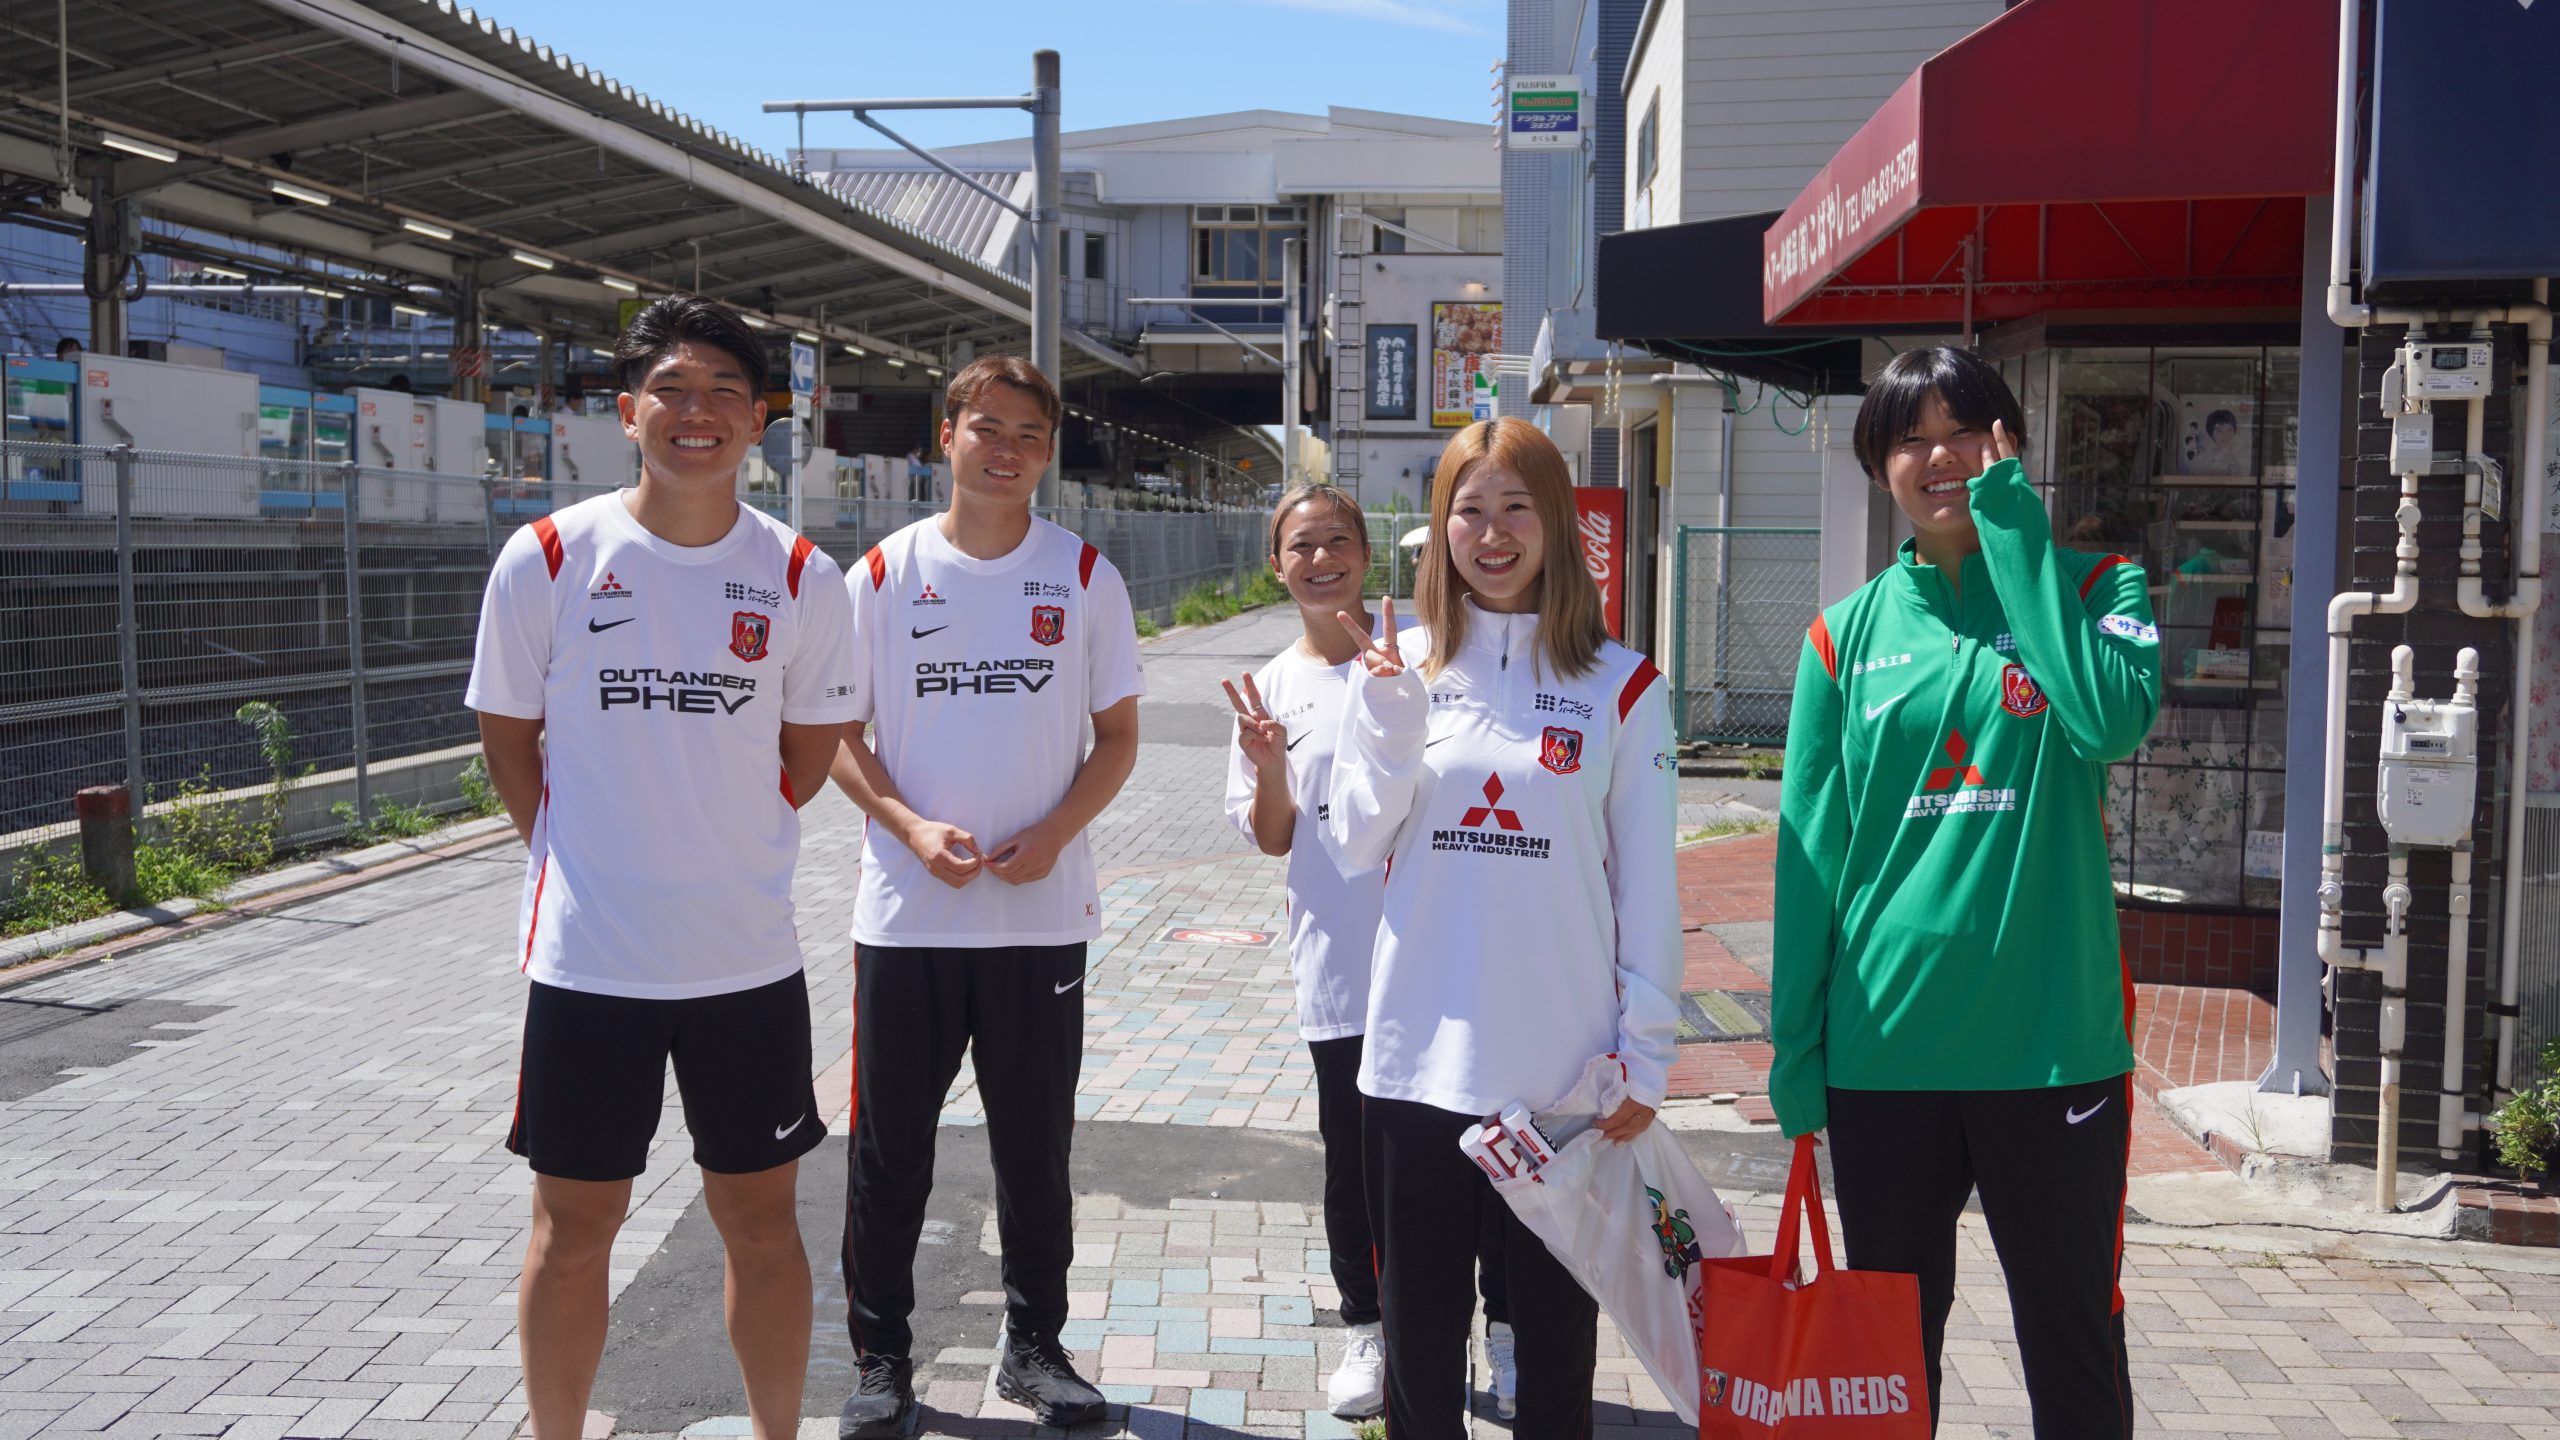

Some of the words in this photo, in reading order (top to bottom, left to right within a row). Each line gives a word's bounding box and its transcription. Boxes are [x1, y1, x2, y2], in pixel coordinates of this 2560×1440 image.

[1517, 81, 1556, 89] FUJIFILM
[1845, 192, 1860, 237] TEL
[1861, 139, 1917, 222] 048-831-7572
[1577, 510, 1611, 580] Cola
[748, 587, 780, 600] トーシン
[1043, 583, 1070, 592] トーシン
[916, 658, 1054, 675] OUTLANDER
[599, 669, 756, 691] OUTLANDER
[916, 673, 1054, 697] PHEV
[600, 687, 755, 715] PHEV
[1559, 697, 1593, 712] トーシン
[1432, 830, 1551, 850] MITSUBISHI
[1432, 842, 1470, 852] HEAVY
[1472, 844, 1549, 859] INDUSTRIES
[1085, 903, 1094, 916] XL
[1829, 1374, 1909, 1415] REDS
